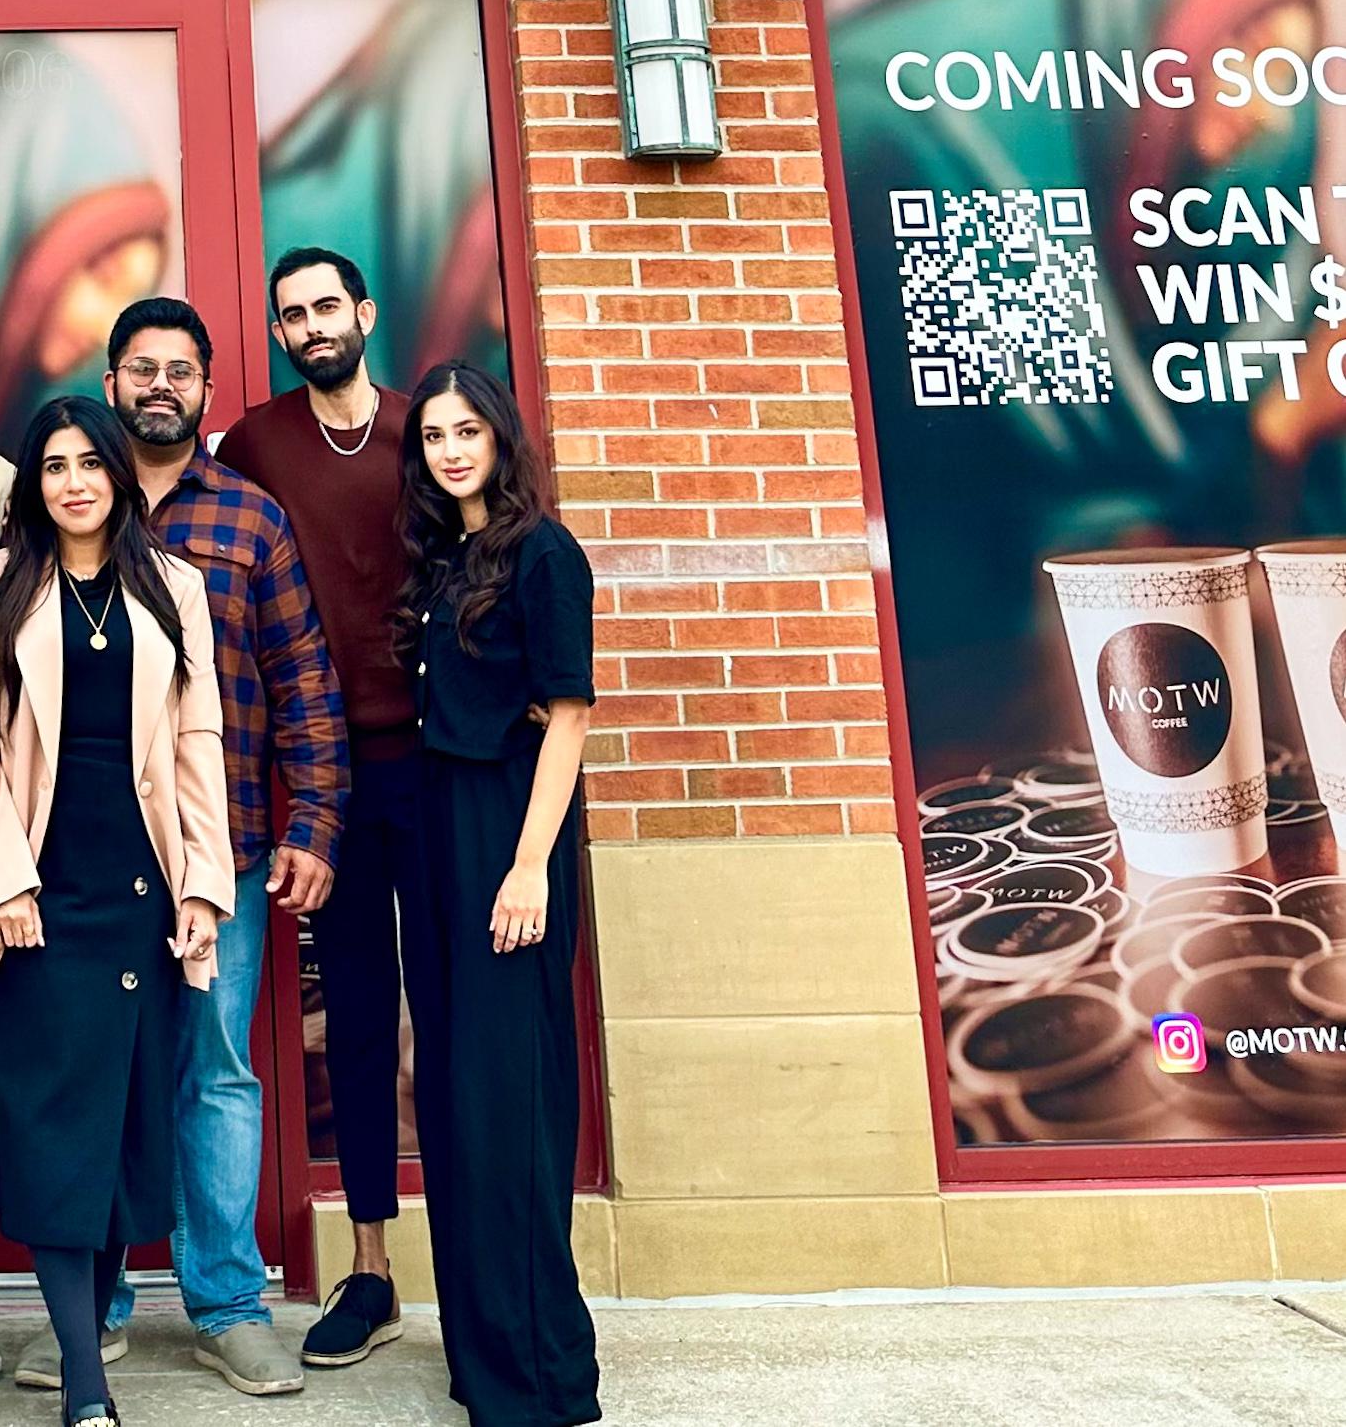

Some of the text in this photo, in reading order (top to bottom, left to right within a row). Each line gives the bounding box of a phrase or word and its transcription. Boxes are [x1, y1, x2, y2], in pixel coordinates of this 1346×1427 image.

[885, 48, 1196, 112] COMING
[1129, 186, 1321, 249] SCAN
[1135, 262, 1295, 325] WIN
[1152, 339, 1308, 404] GIFT
[1108, 677, 1220, 714] MOTW
[1151, 717, 1189, 730] COFFEE
[987, 886, 1073, 900] MOTW
[1225, 1026, 1346, 1059] @MOTW.
